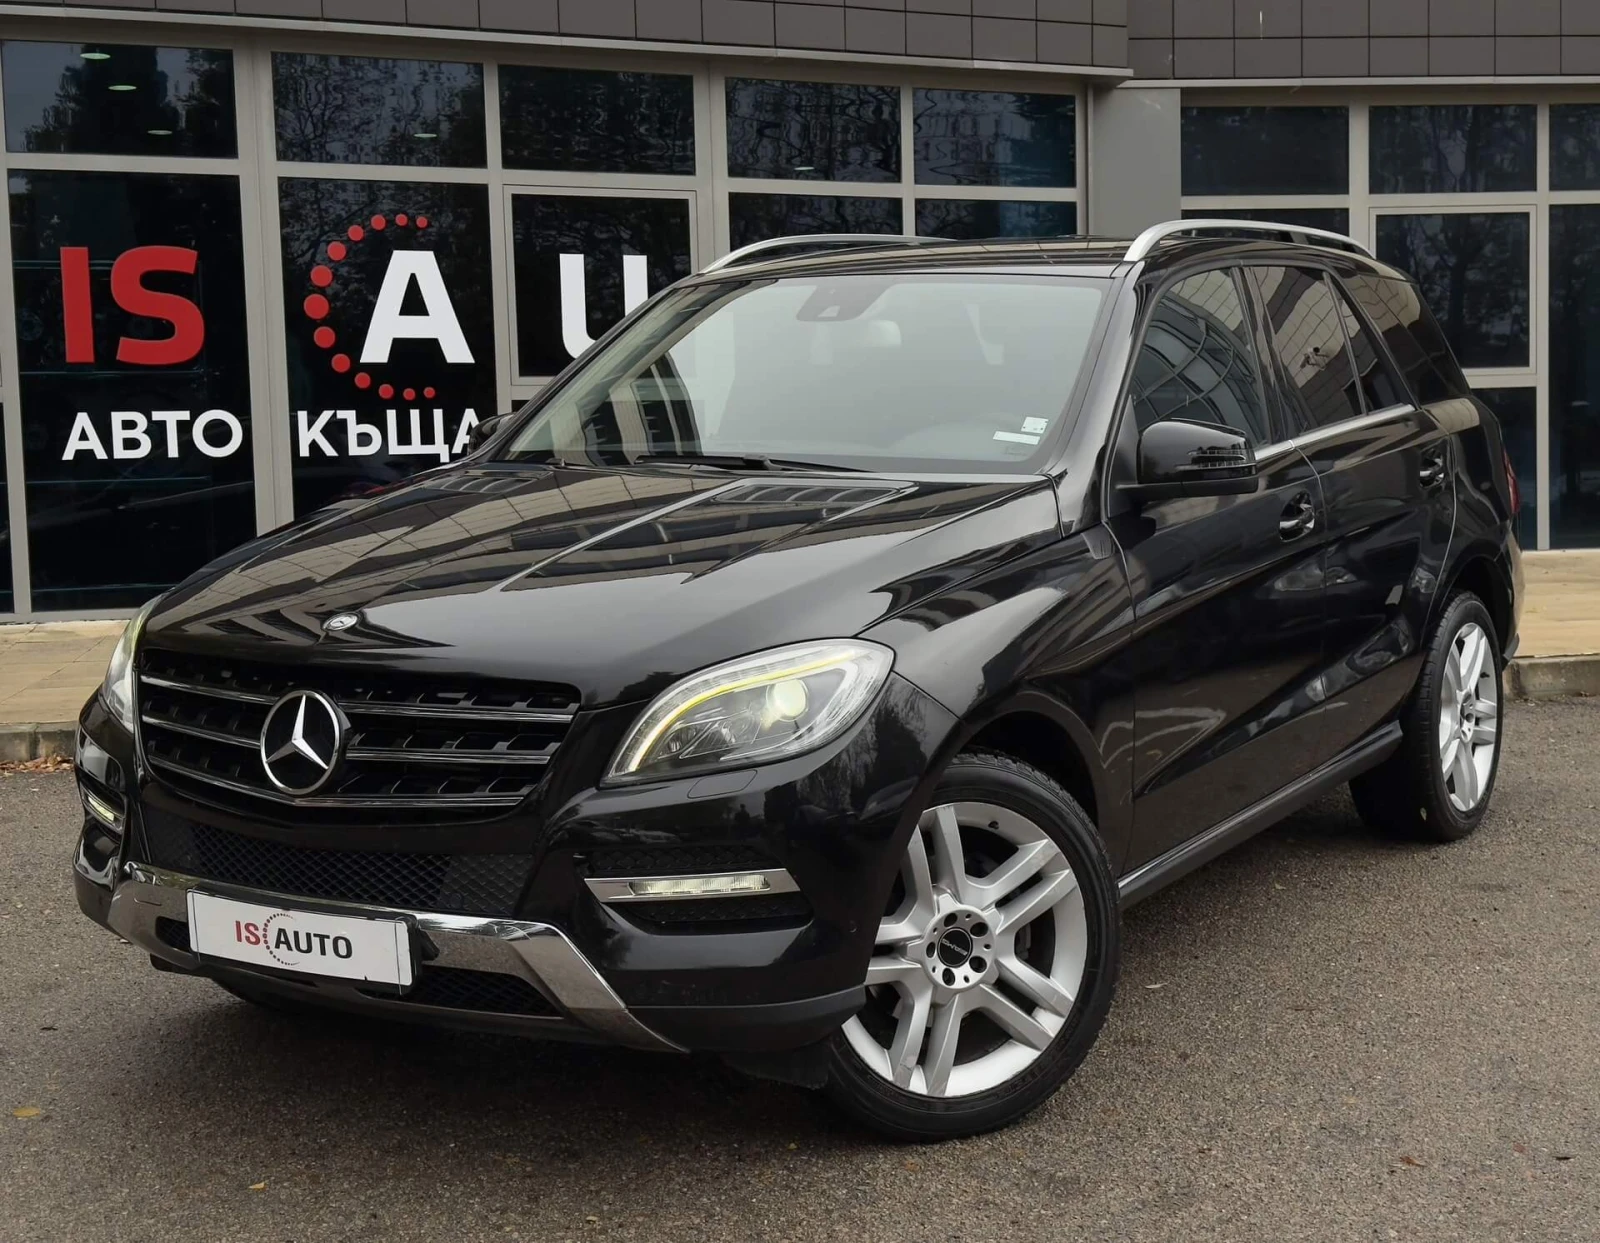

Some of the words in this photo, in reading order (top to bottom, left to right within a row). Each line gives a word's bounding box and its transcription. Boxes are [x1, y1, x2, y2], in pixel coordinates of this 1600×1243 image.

[60, 245, 206, 366] IS
[61, 409, 243, 461] АВТО
[235, 920, 261, 946] IS
[274, 928, 353, 960] AUTO
